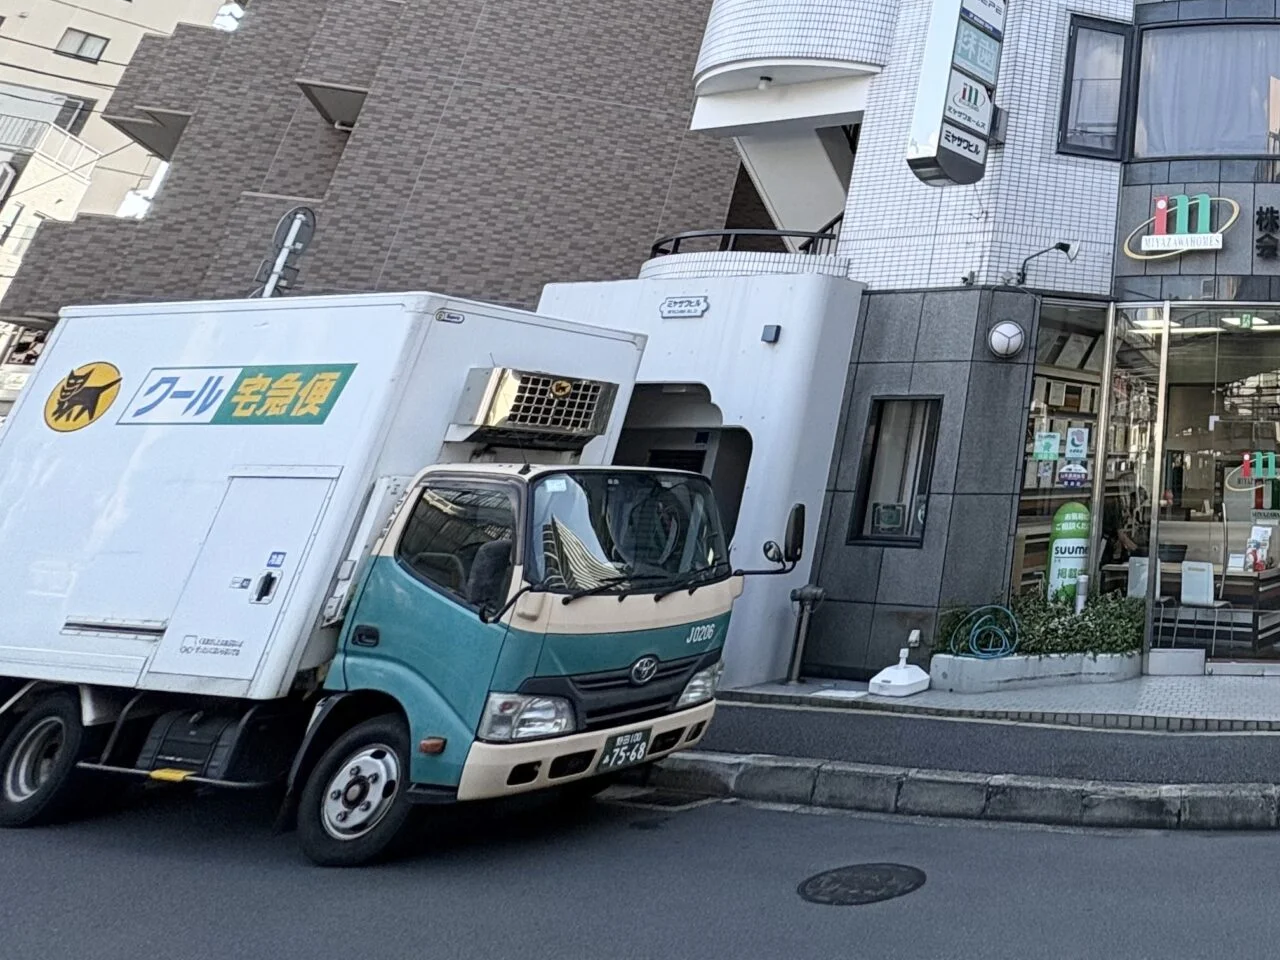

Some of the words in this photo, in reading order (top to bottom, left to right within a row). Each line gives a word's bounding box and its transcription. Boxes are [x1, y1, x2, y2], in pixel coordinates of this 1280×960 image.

[944, 129, 981, 156] ミヤザワビル
